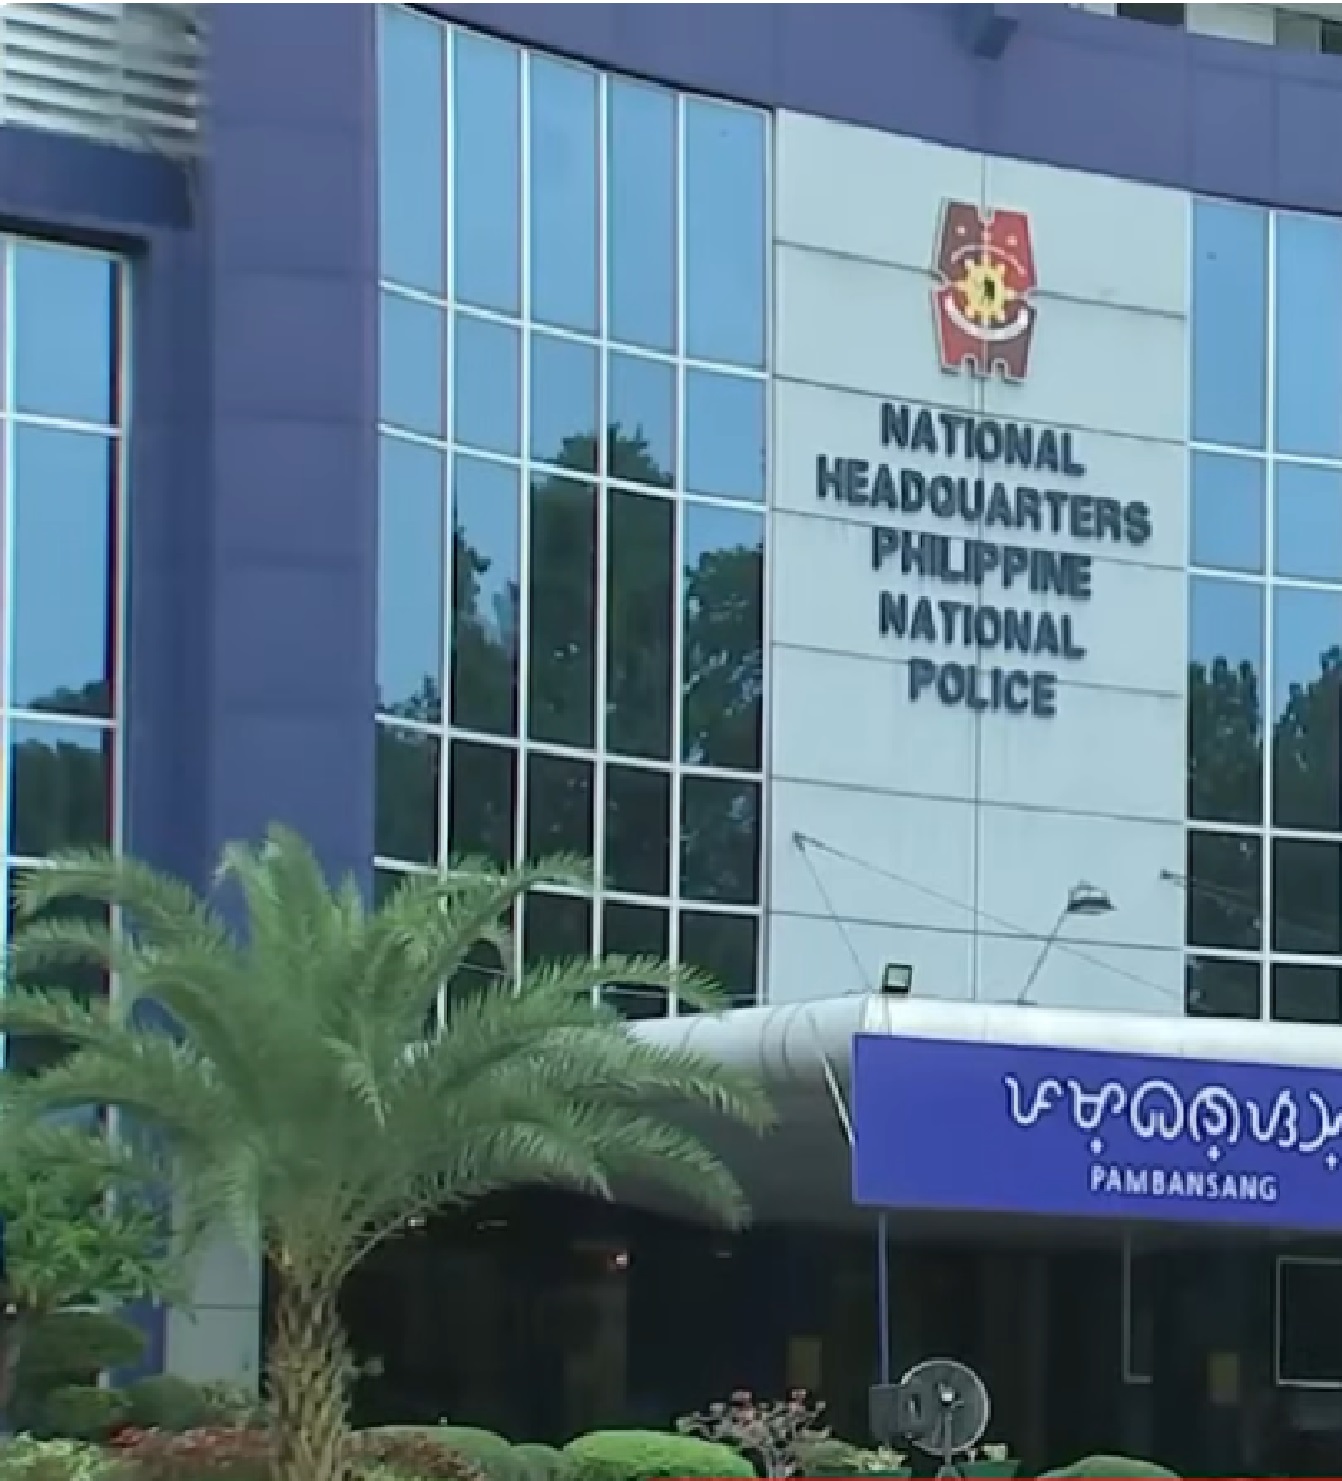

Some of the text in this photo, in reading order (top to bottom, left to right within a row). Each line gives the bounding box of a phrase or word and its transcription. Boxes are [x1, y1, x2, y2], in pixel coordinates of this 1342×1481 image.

[880, 402, 1085, 476] NATIONAL
[816, 454, 1152, 545] HEADQUARTERS
[872, 527, 1092, 598] PHILIPPINE
[878, 590, 1085, 658] NATIONAL
[909, 656, 1057, 717] POLICE
[1090, 1164, 1278, 1202] PAMBANSANG
